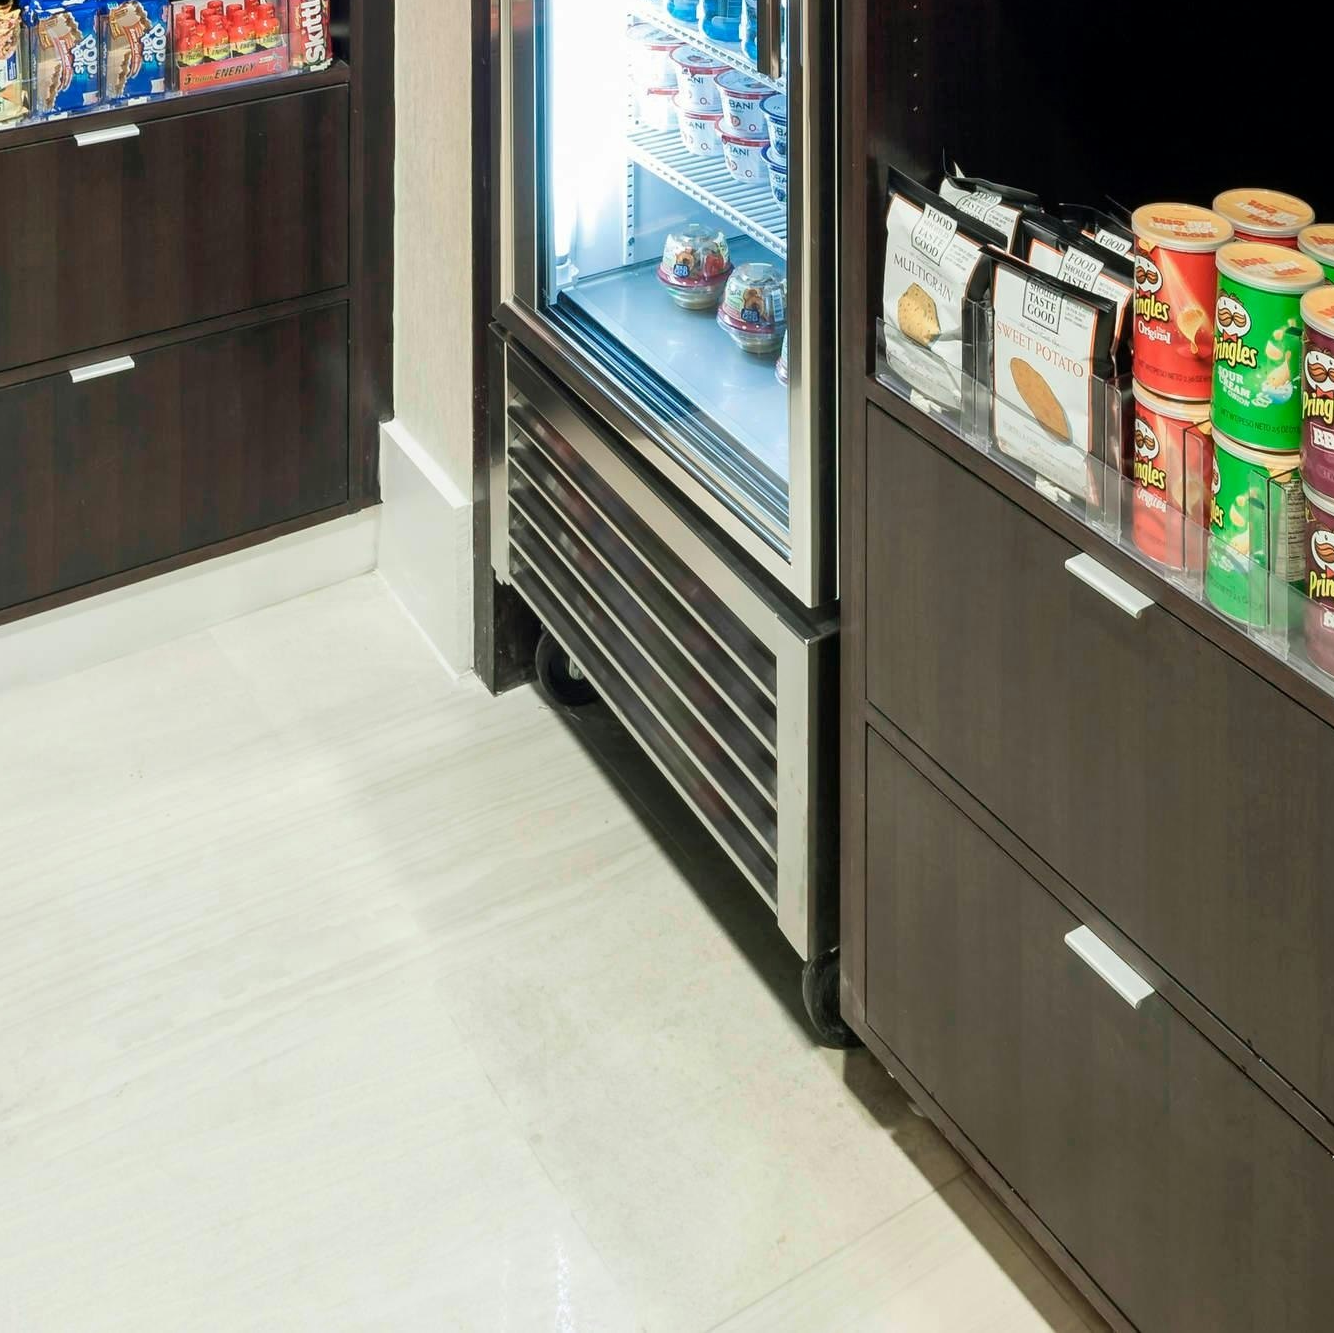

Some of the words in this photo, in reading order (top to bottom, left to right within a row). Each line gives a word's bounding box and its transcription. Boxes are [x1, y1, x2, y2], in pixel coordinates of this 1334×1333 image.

[215, 63, 256, 80] ENERGY
[729, 100, 753, 110] BANI
[927, 209, 953, 232] FOOD
[913, 236, 940, 258] GOOD
[1064, 262, 1092, 281] SHOULD
[1067, 253, 1097, 272] FOOD
[893, 253, 954, 302] MULTIGRAIN
[1028, 292, 1057, 312] TASTE
[1026, 306, 1056, 326] GOOD
[1138, 322, 1171, 345] Original
[995, 320, 1034, 350] SWEET
[1035, 341, 1084, 378] POTATO
